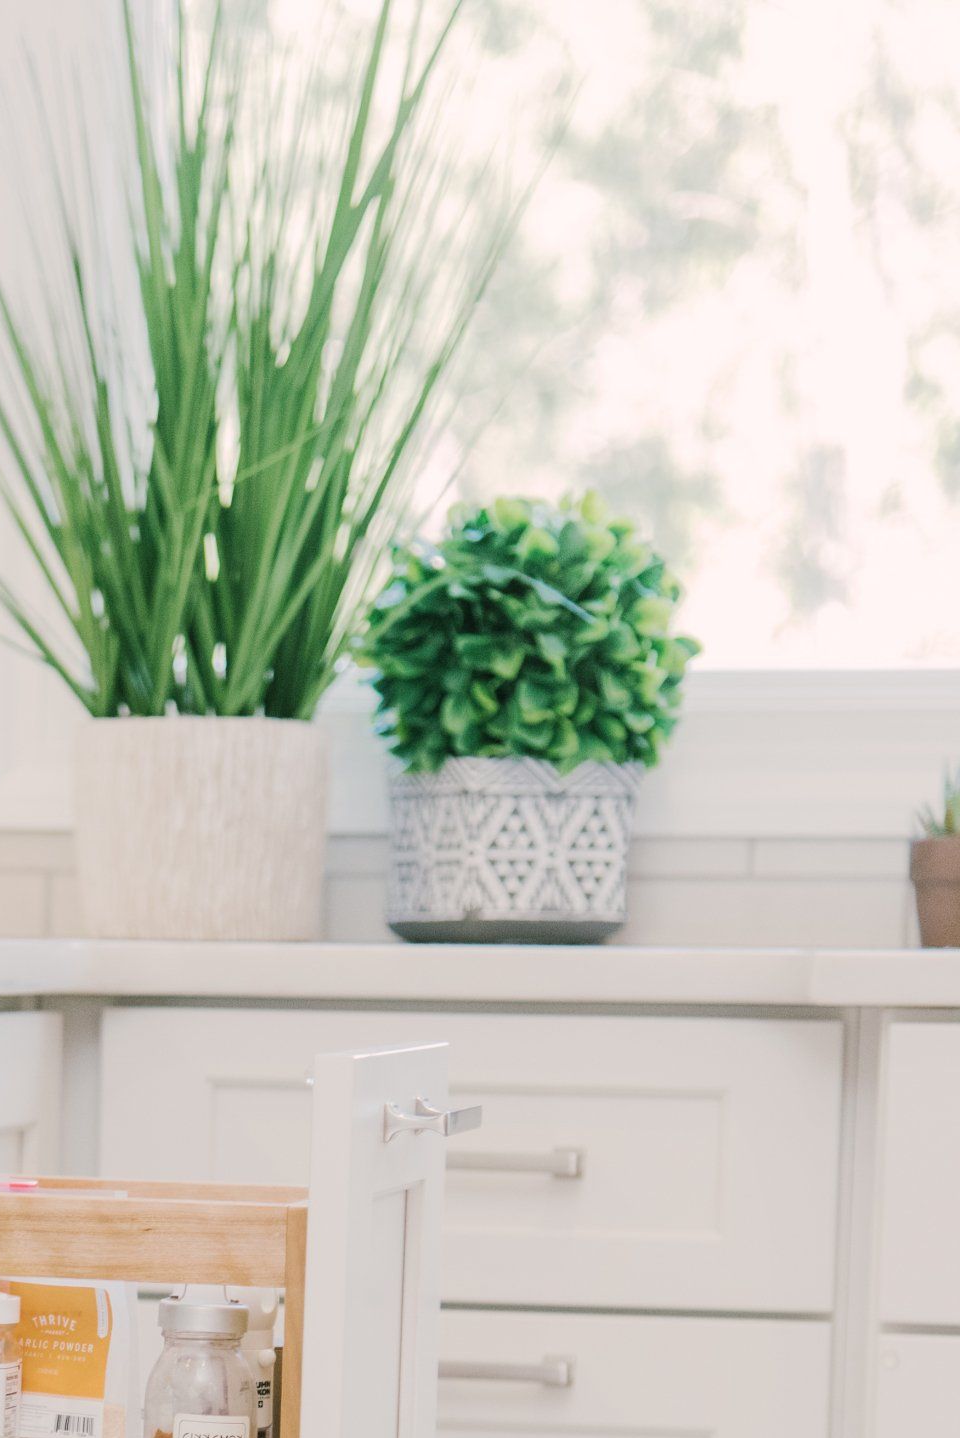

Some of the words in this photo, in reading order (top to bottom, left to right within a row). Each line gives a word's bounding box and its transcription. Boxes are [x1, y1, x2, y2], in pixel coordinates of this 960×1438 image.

[32, 1313, 77, 1331] THRIVE
[18, 1337, 49, 1350] ARLIC
[52, 1340, 95, 1353] POWDER
